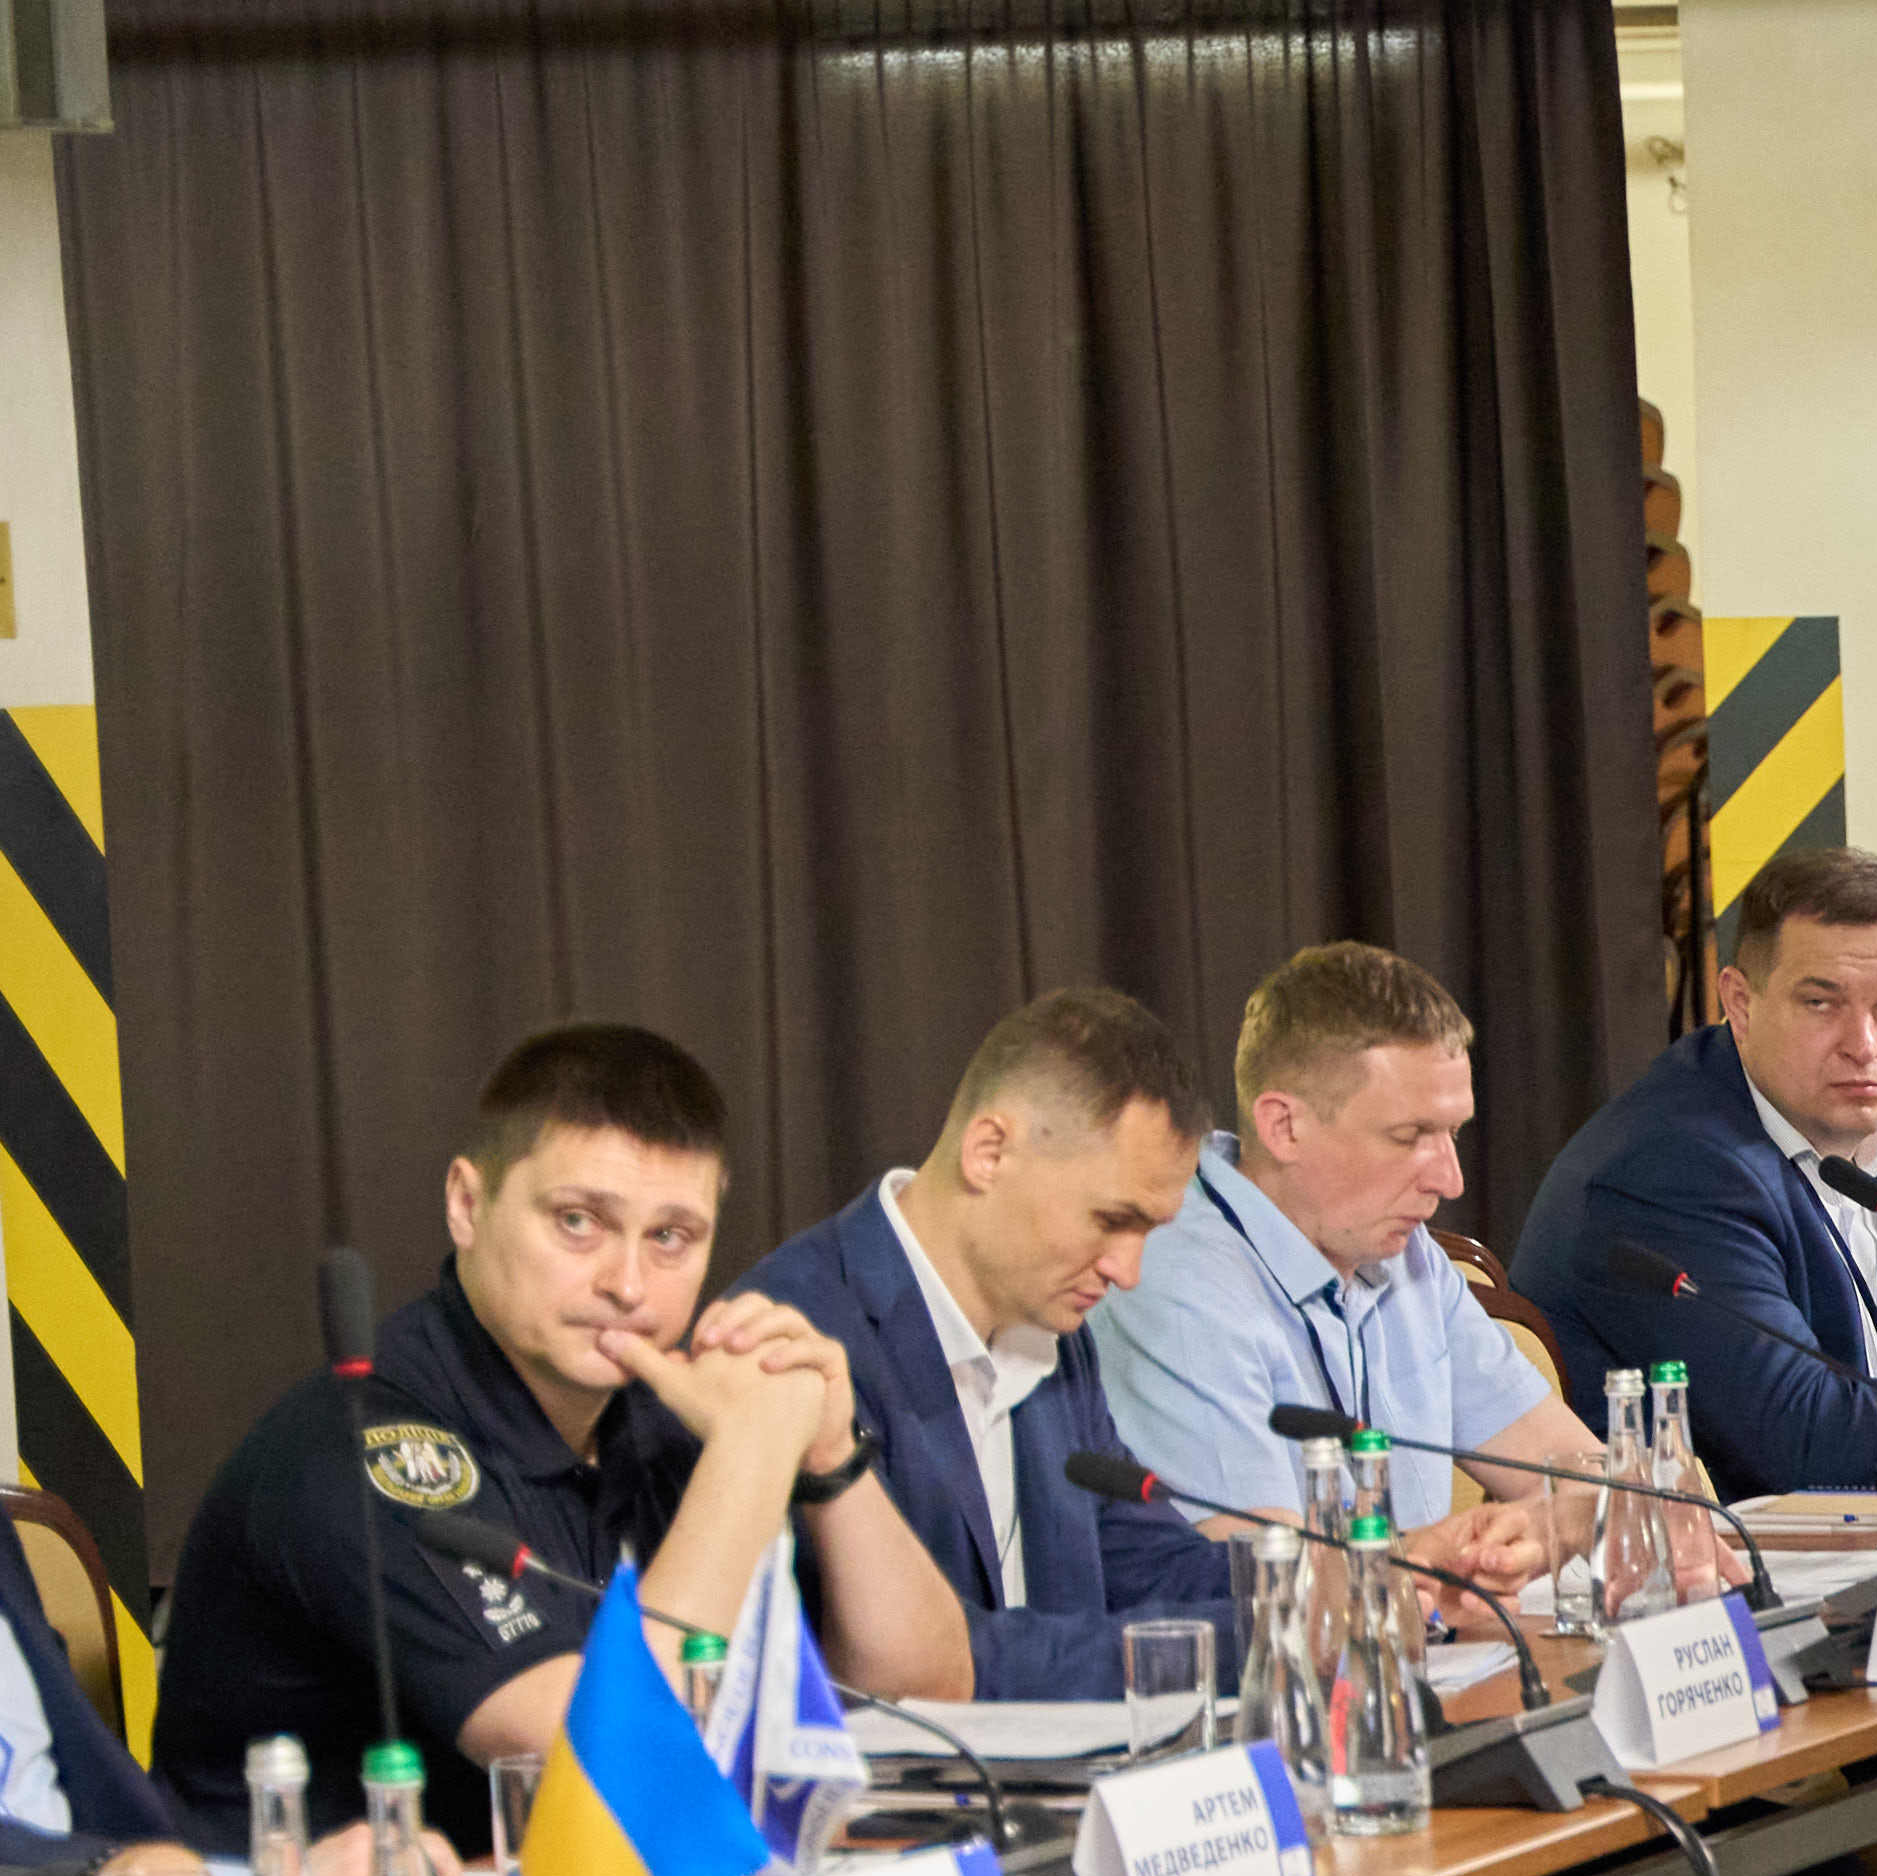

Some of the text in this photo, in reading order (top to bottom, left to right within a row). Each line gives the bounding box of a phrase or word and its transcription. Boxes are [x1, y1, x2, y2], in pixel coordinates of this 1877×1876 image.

[1673, 1633, 1735, 1671] РУСЛАН
[1657, 1671, 1744, 1720] ГОРЯЧЕНКО
[1191, 1786, 1259, 1825] АРТЕМ
